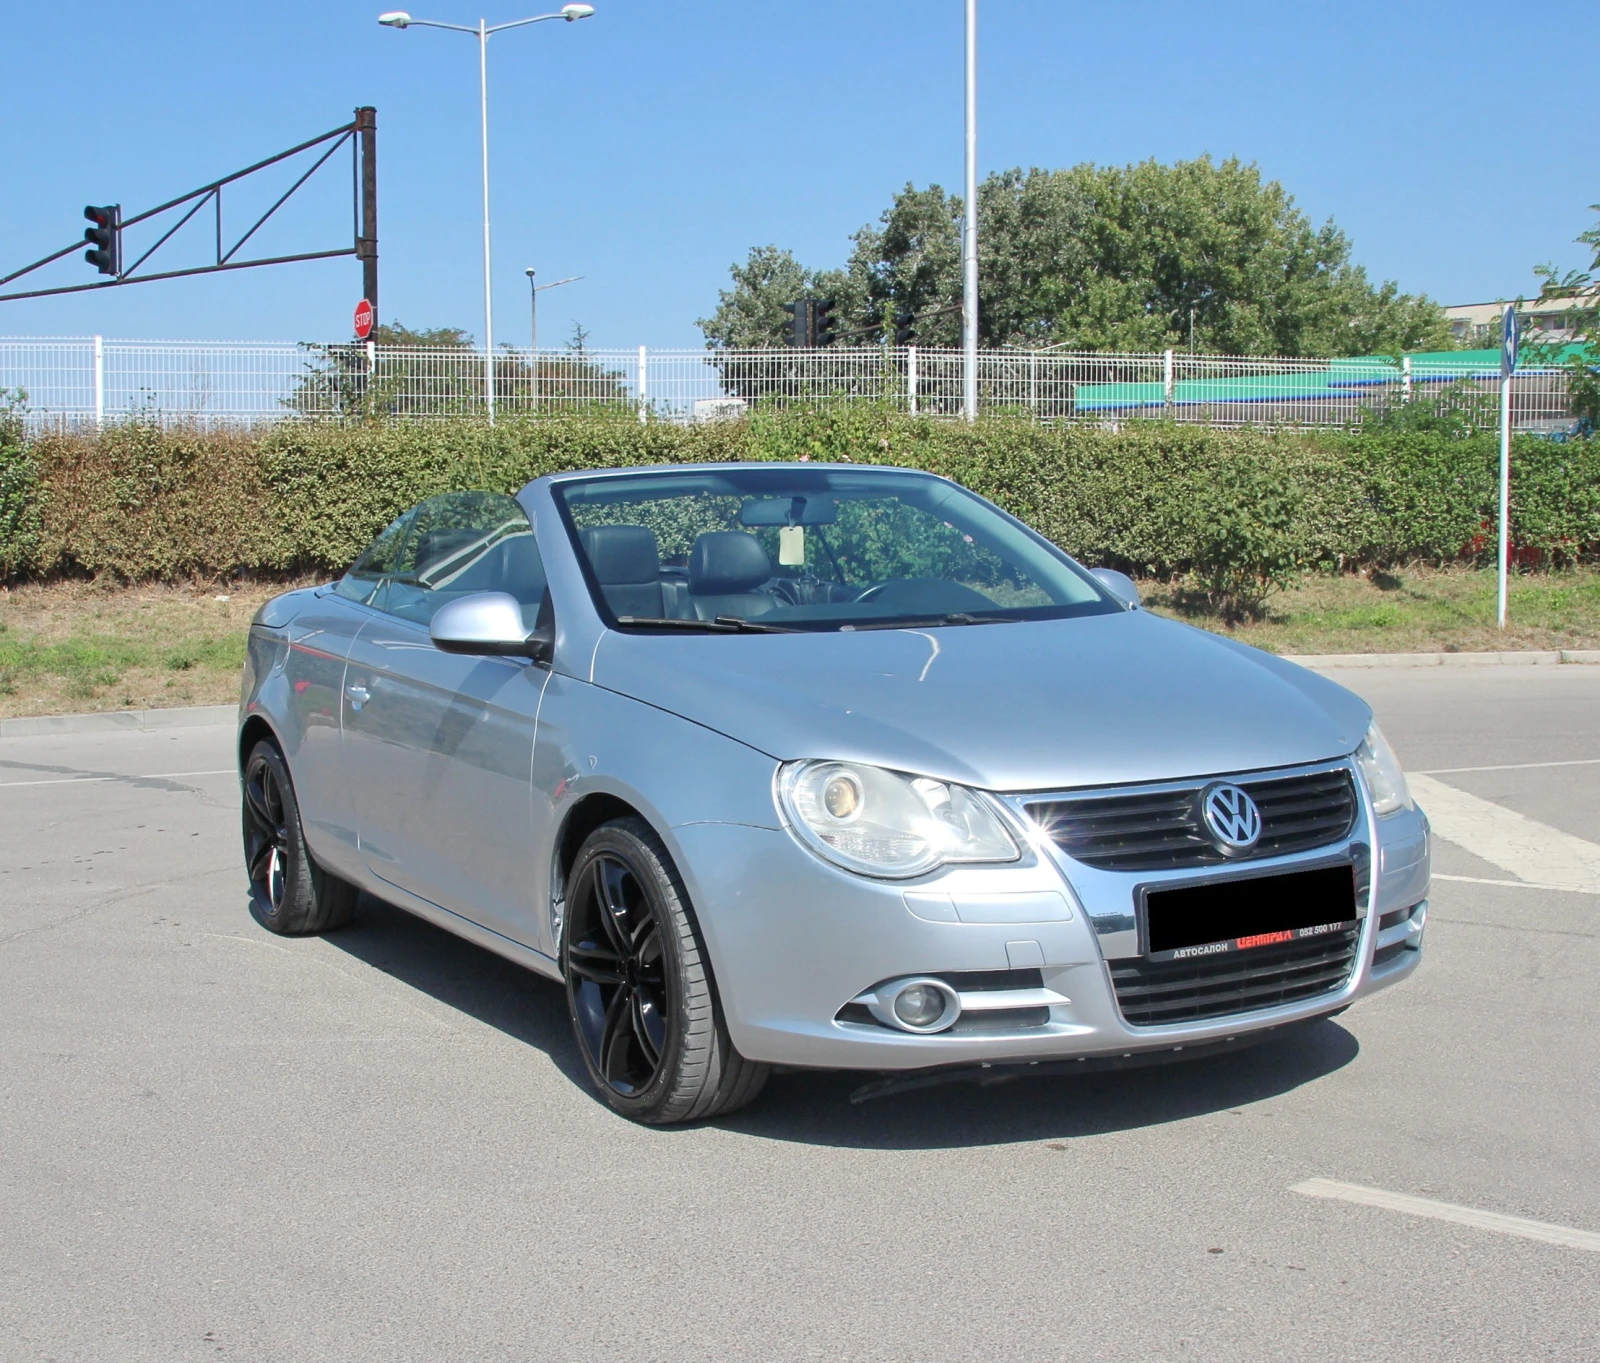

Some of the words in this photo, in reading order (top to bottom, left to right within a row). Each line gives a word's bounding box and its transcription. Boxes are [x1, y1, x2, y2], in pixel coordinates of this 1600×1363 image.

[356, 311, 370, 328] STOP
[1206, 785, 1259, 845] VW
[1173, 943, 1228, 959] АВТОСАЛОН
[1299, 926, 1313, 937] 052
[1313, 924, 1328, 934] 500
[1328, 921, 1342, 931] 177
